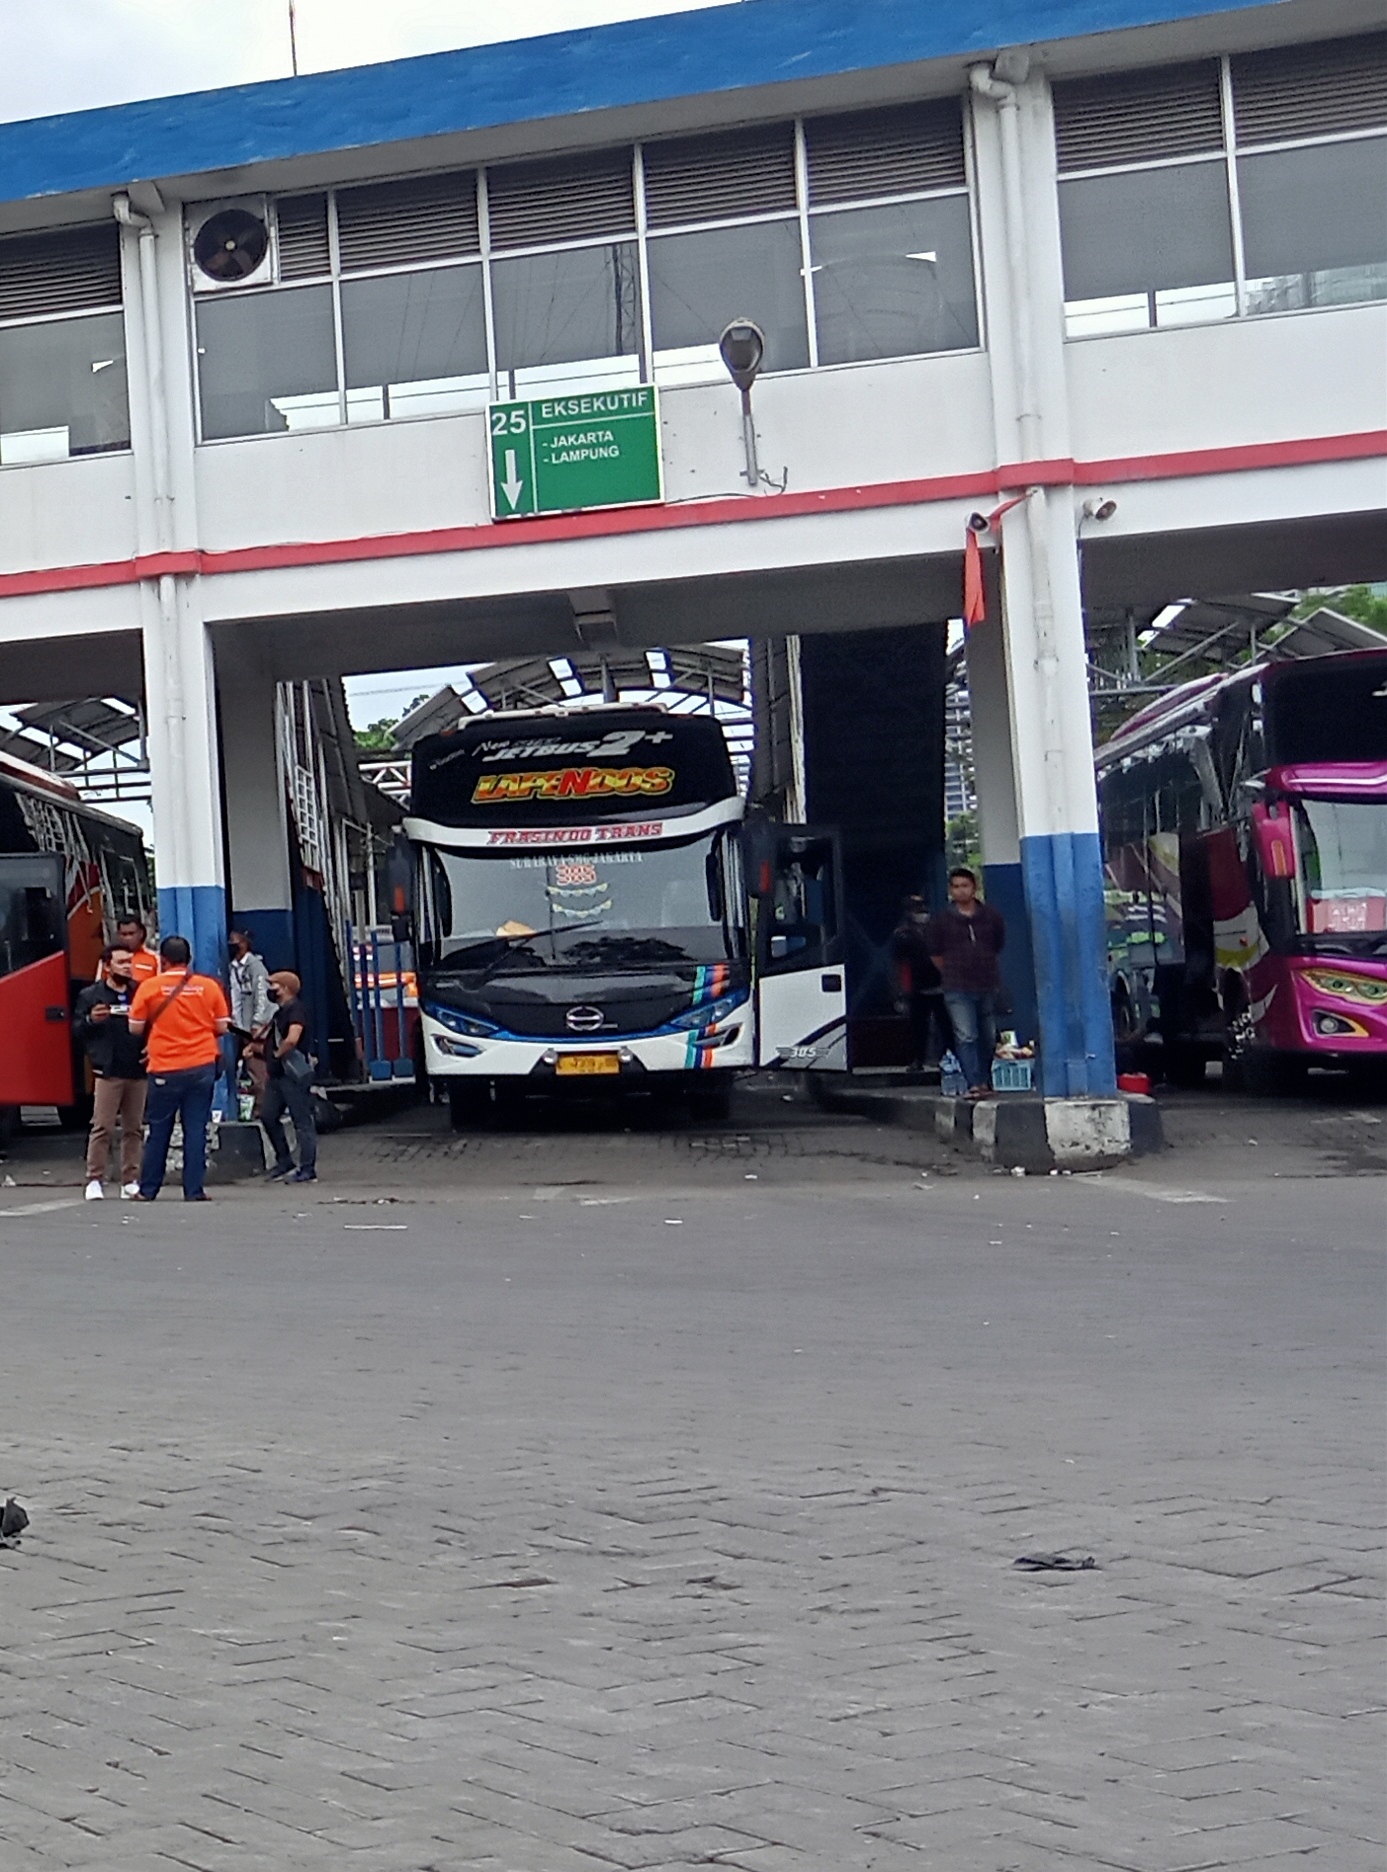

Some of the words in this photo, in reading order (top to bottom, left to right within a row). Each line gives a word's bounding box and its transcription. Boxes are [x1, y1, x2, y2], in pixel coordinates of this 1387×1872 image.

[541, 391, 648, 418] EKSEKUTIF
[492, 410, 526, 435] 25
[550, 430, 614, 448] JAKARTA
[551, 445, 619, 464] LAMPUNG
[594, 822, 664, 840] TRANS
